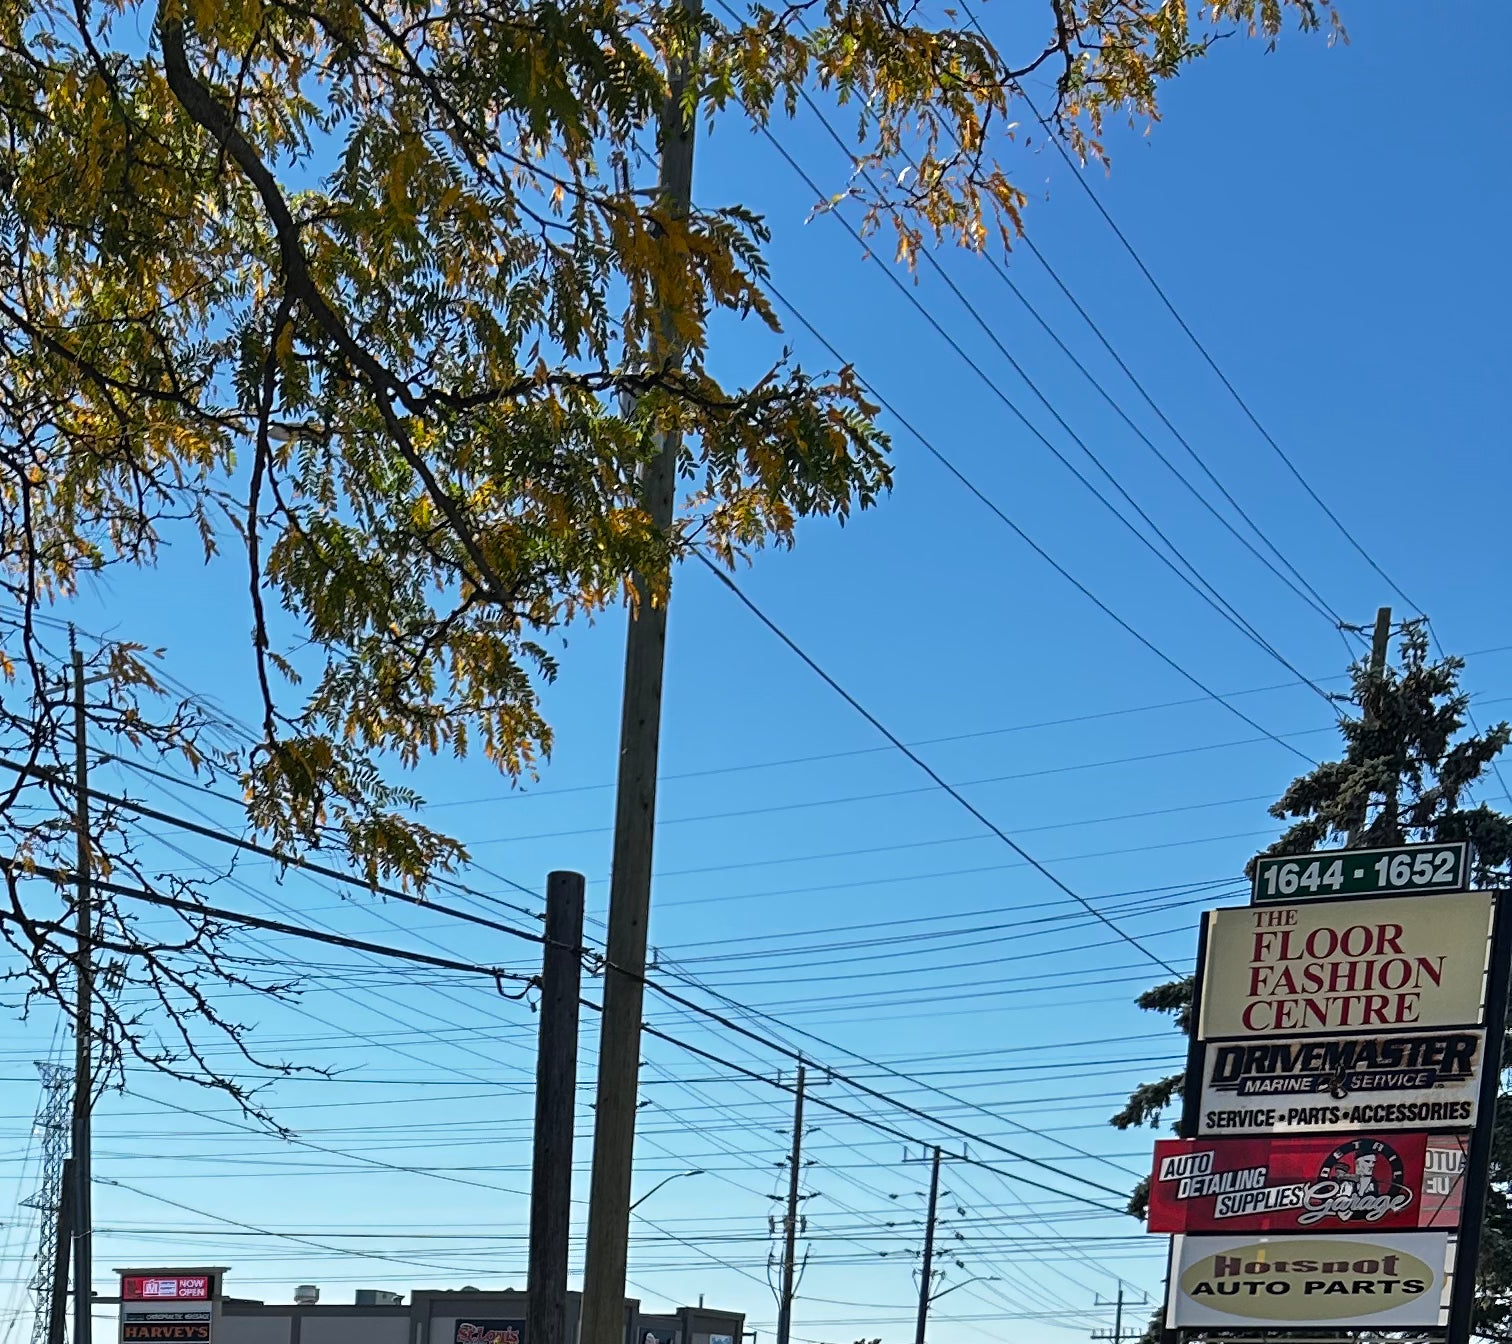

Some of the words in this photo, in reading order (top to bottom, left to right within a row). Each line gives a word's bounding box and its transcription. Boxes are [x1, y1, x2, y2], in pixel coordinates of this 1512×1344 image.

[1263, 860, 1345, 895] 1644
[1373, 850, 1456, 888] 1652
[1252, 909, 1299, 928] THE
[1249, 923, 1406, 963] FLOOR
[1247, 955, 1447, 998] FASHION
[1241, 992, 1421, 1032] CENTRE
[1210, 1033, 1480, 1083] DRIVEMASTER
[1244, 1077, 1313, 1093] MARINE
[1350, 1071, 1429, 1089] SERVICE
[1205, 1108, 1276, 1129] SERVICE
[1288, 1105, 1341, 1126] PARTS
[1348, 1100, 1471, 1123] ACCESSORIES
[1163, 1152, 1211, 1179] AUTO
[1177, 1167, 1267, 1200] DETAILING
[1218, 1186, 1302, 1217] SUPPLIES
[1297, 1179, 1414, 1225] Garage
[179, 1279, 205, 1288] NOW
[179, 1288, 205, 1297] OPEN
[1190, 1280, 1291, 1297] AUTO
[1303, 1278, 1426, 1296] PARTS
[124, 1326, 209, 1339] HARVEY'S
